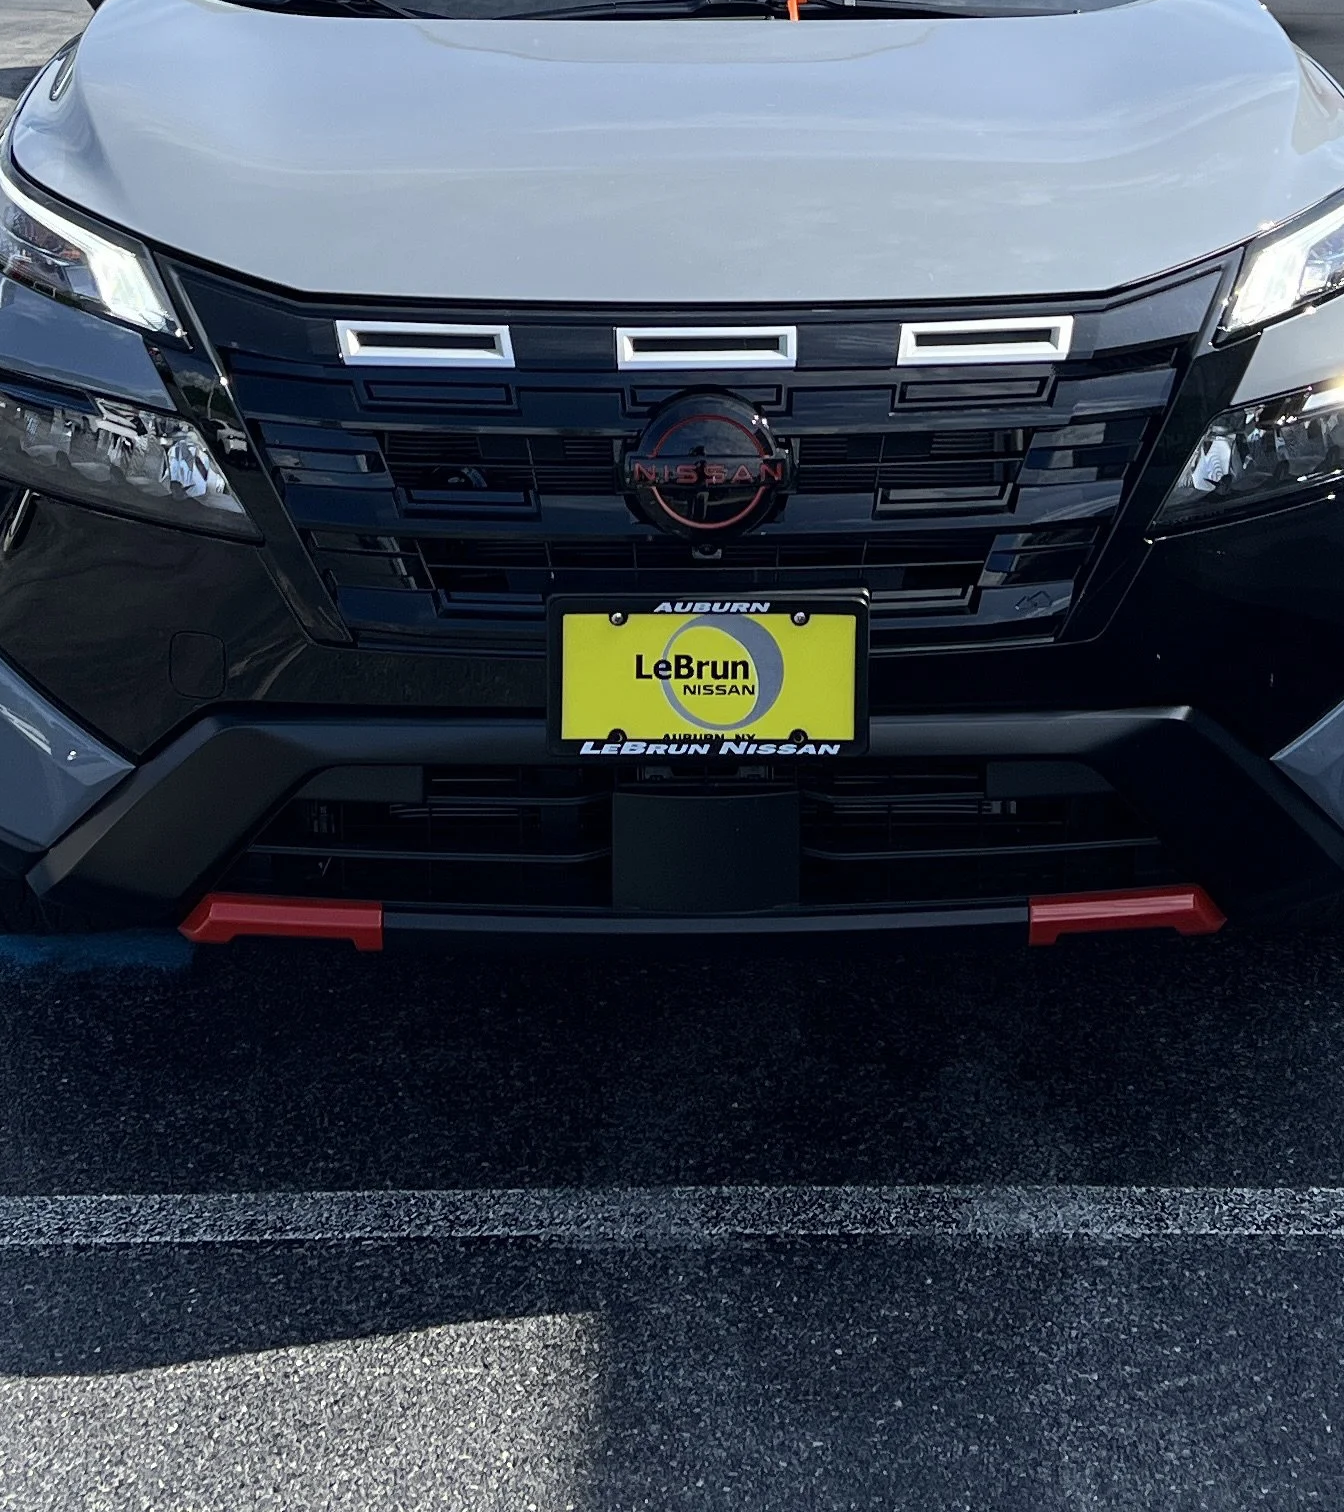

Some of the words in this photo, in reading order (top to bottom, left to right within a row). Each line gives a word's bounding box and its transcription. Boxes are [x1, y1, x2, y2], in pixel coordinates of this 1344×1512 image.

[634, 462, 783, 485] NISSAN
[653, 601, 771, 614] AUBURN
[635, 654, 750, 681] LeBrun
[682, 684, 756, 696] NISSAN
